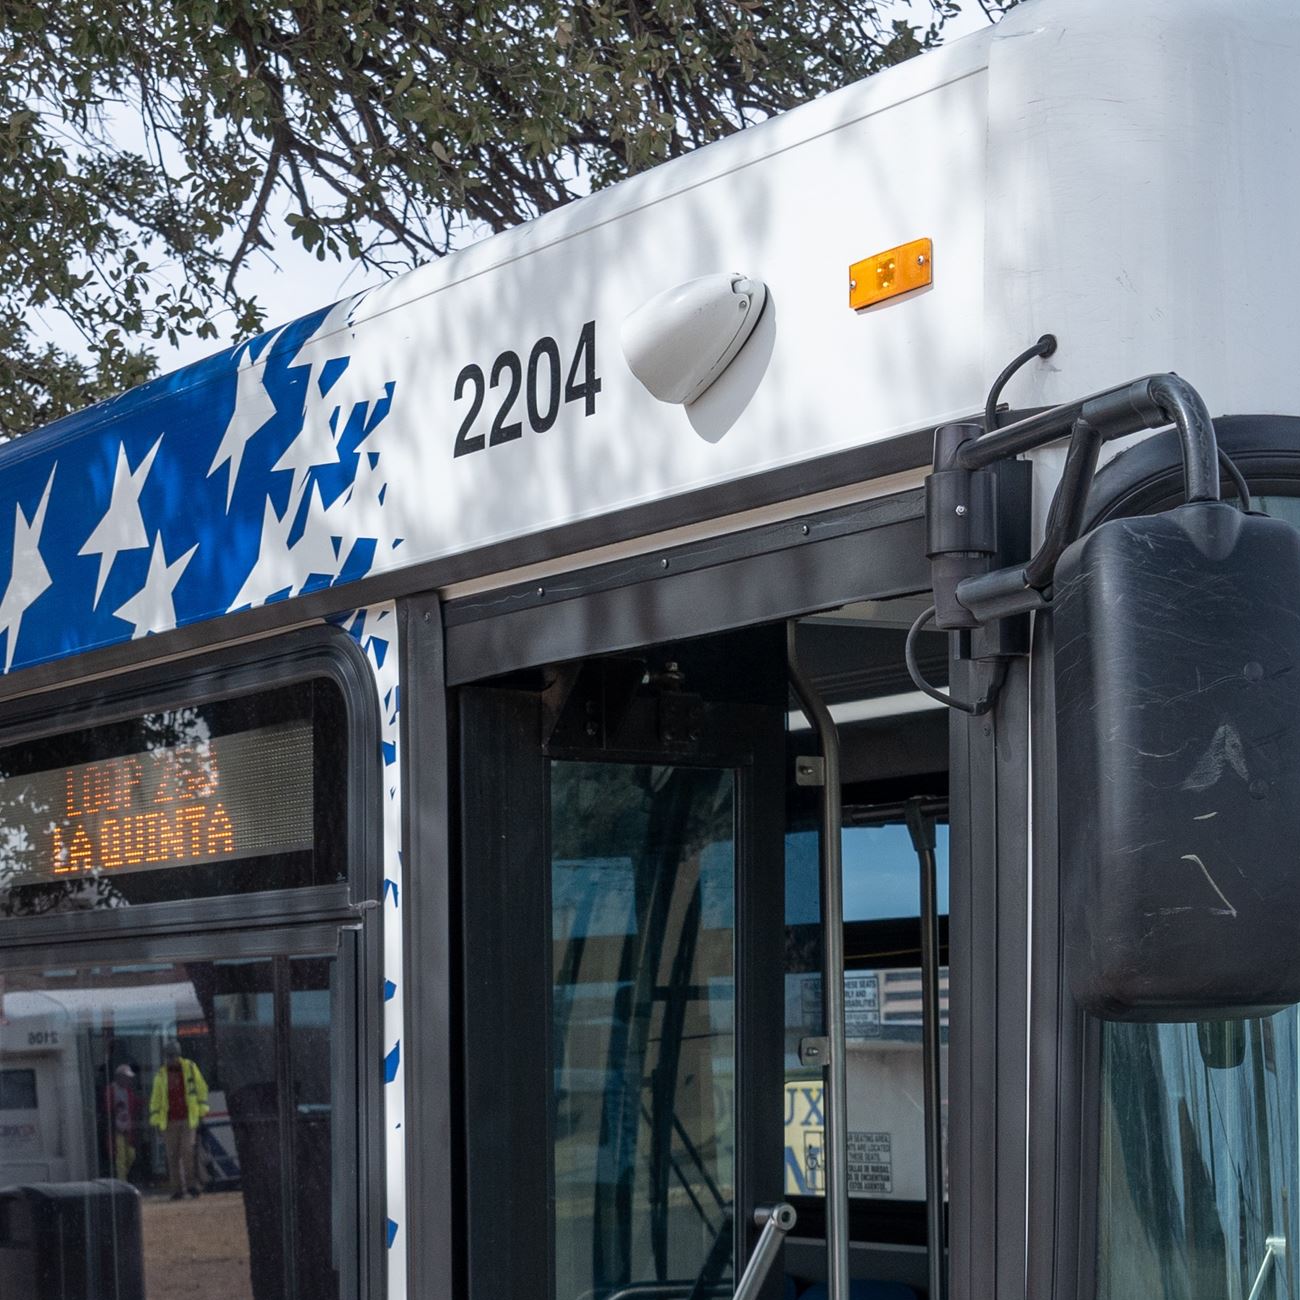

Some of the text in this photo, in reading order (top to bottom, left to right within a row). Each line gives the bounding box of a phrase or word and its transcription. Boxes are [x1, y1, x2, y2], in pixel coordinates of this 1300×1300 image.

[453, 319, 602, 459] 2204
[66, 759, 142, 817] LOOP
[53, 803, 233, 873] LA QUINTA
